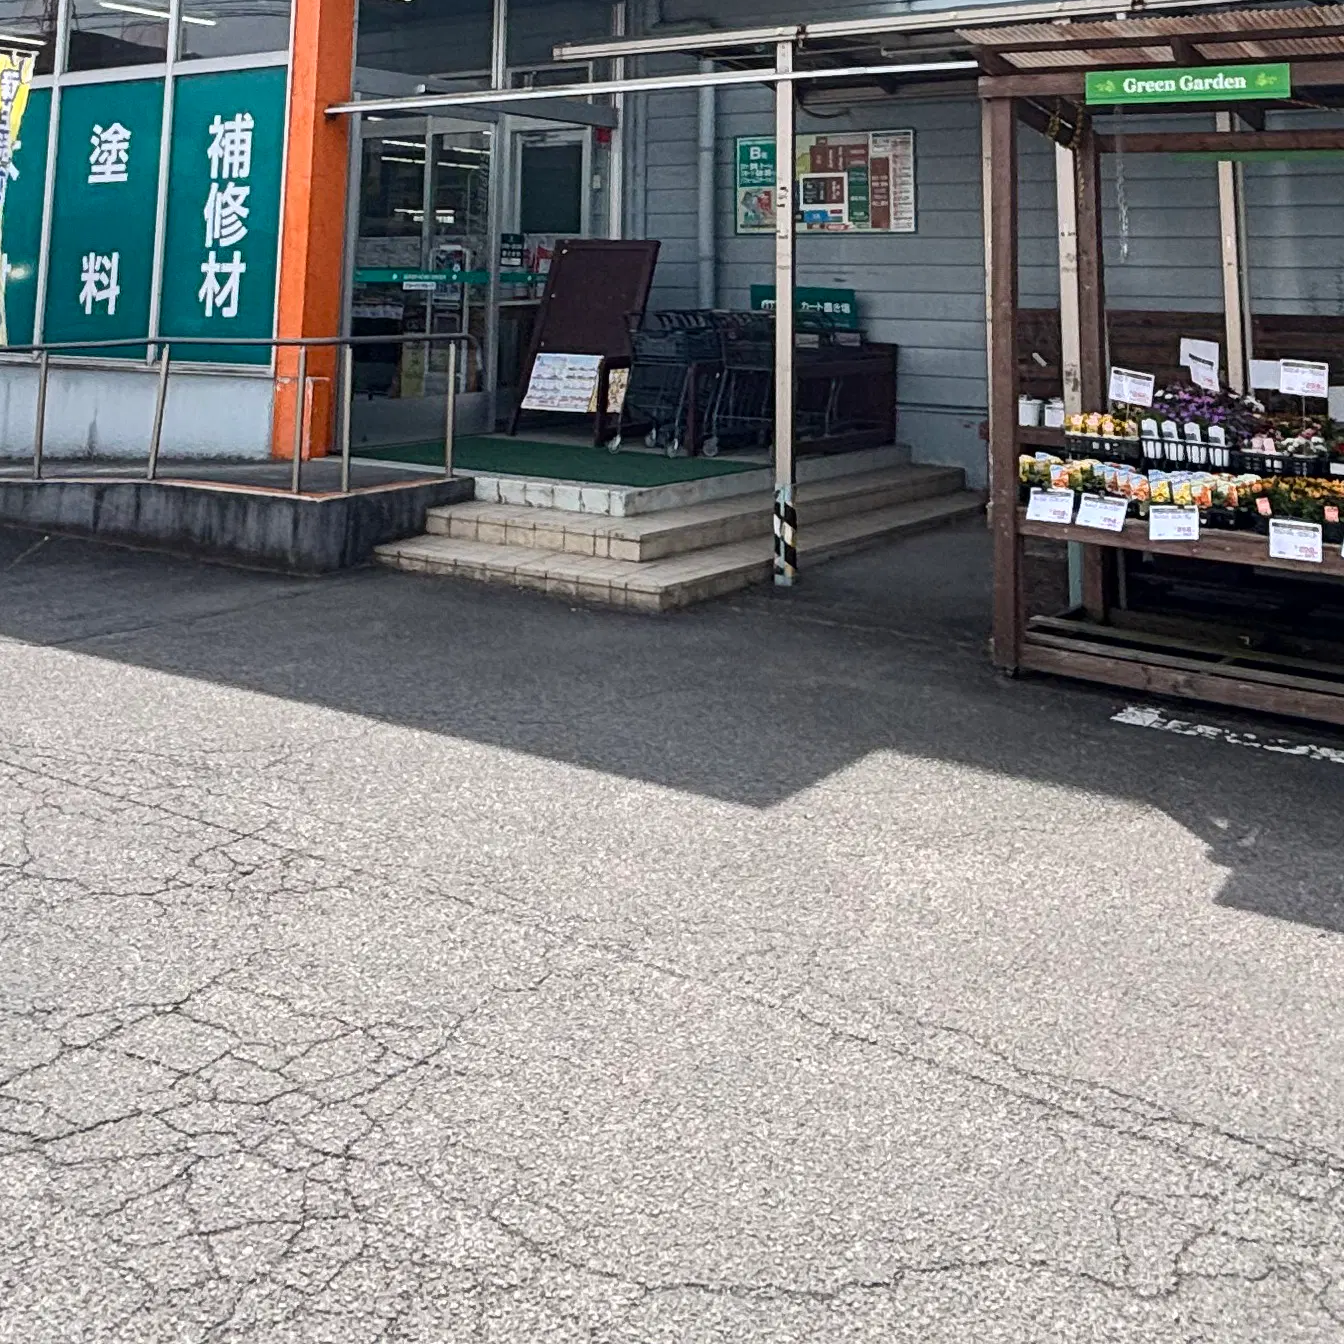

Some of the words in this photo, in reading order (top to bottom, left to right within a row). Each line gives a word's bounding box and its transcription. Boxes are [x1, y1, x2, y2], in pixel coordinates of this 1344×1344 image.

[1122, 77, 1176, 94] Green
[1179, 72, 1247, 92] Garden
[78, 122, 133, 316] 塗料
[198, 112, 255, 318] 補修材
